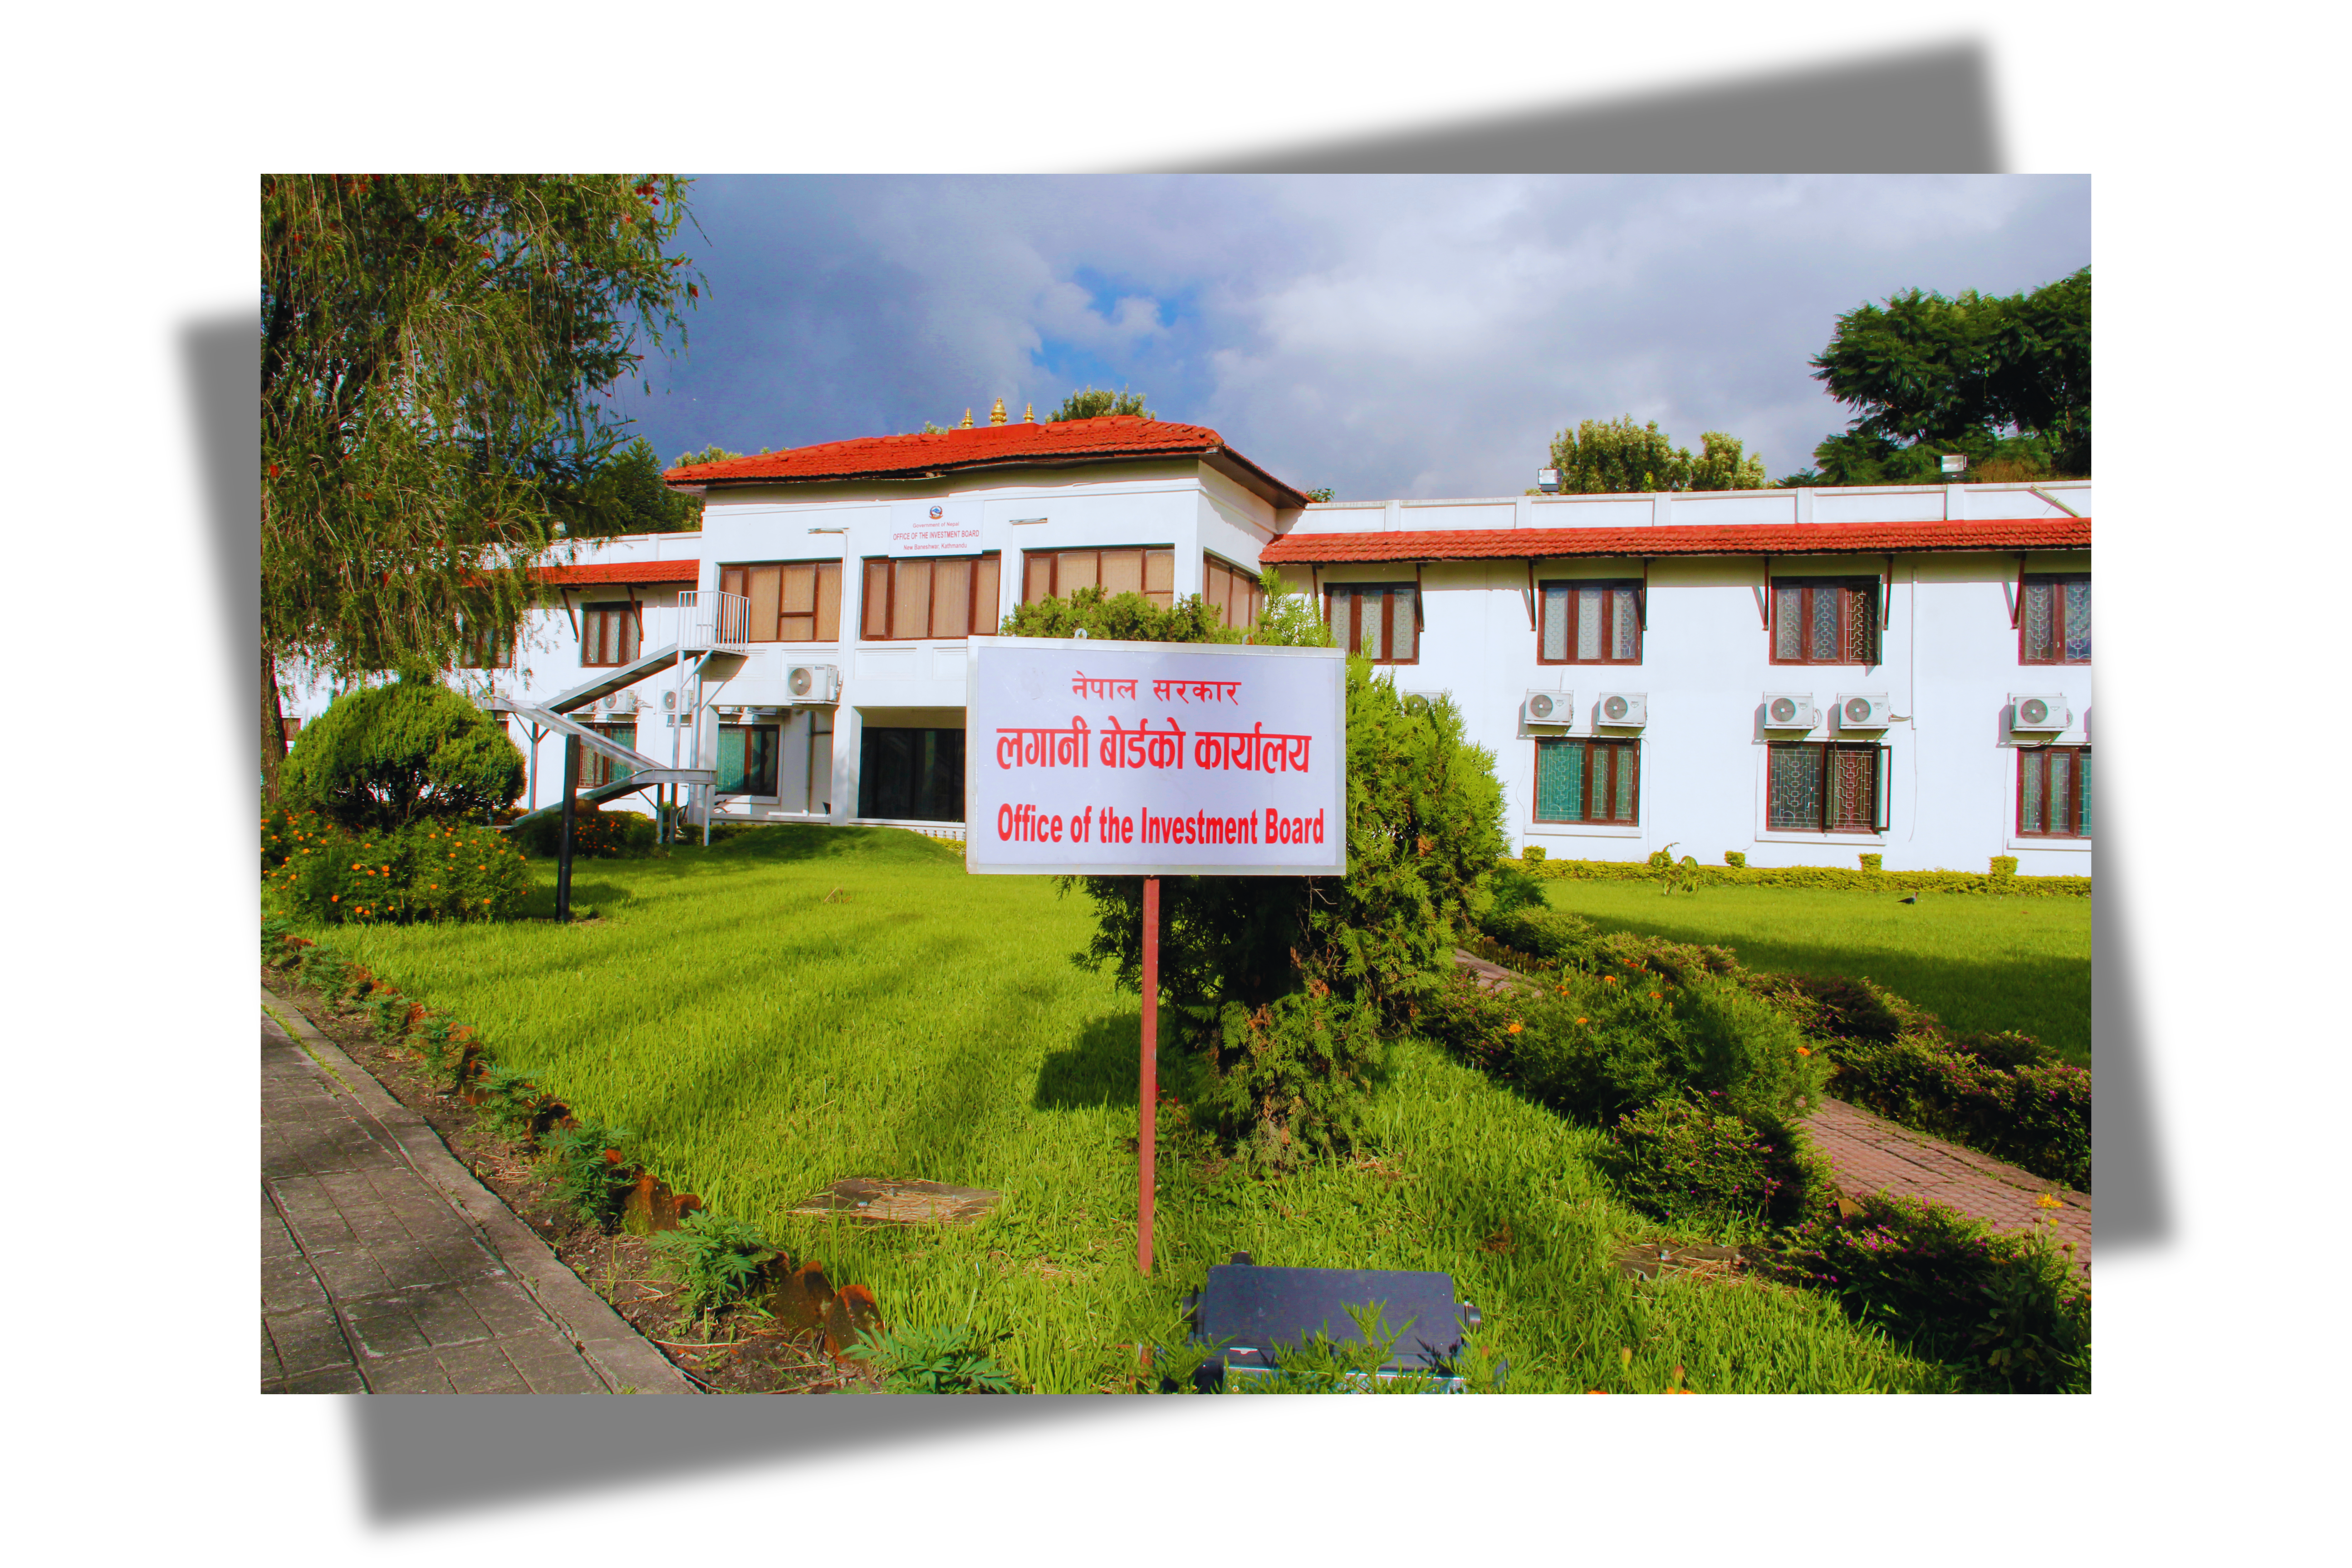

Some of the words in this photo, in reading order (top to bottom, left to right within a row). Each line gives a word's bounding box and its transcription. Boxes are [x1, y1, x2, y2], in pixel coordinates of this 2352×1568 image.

[1072, 671, 1138, 701] नेपाल
[1152, 680, 1242, 706] सरकार
[996, 715, 1091, 769] लगानी
[1100, 716, 1186, 769] बोर्डको
[1195, 721, 1312, 774] कार्यालय
[998, 803, 1063, 843] Office
[1070, 805, 1092, 843] of
[1099, 806, 1133, 844] the
[1142, 807, 1258, 844] Investment
[1265, 808, 1324, 844] Board
